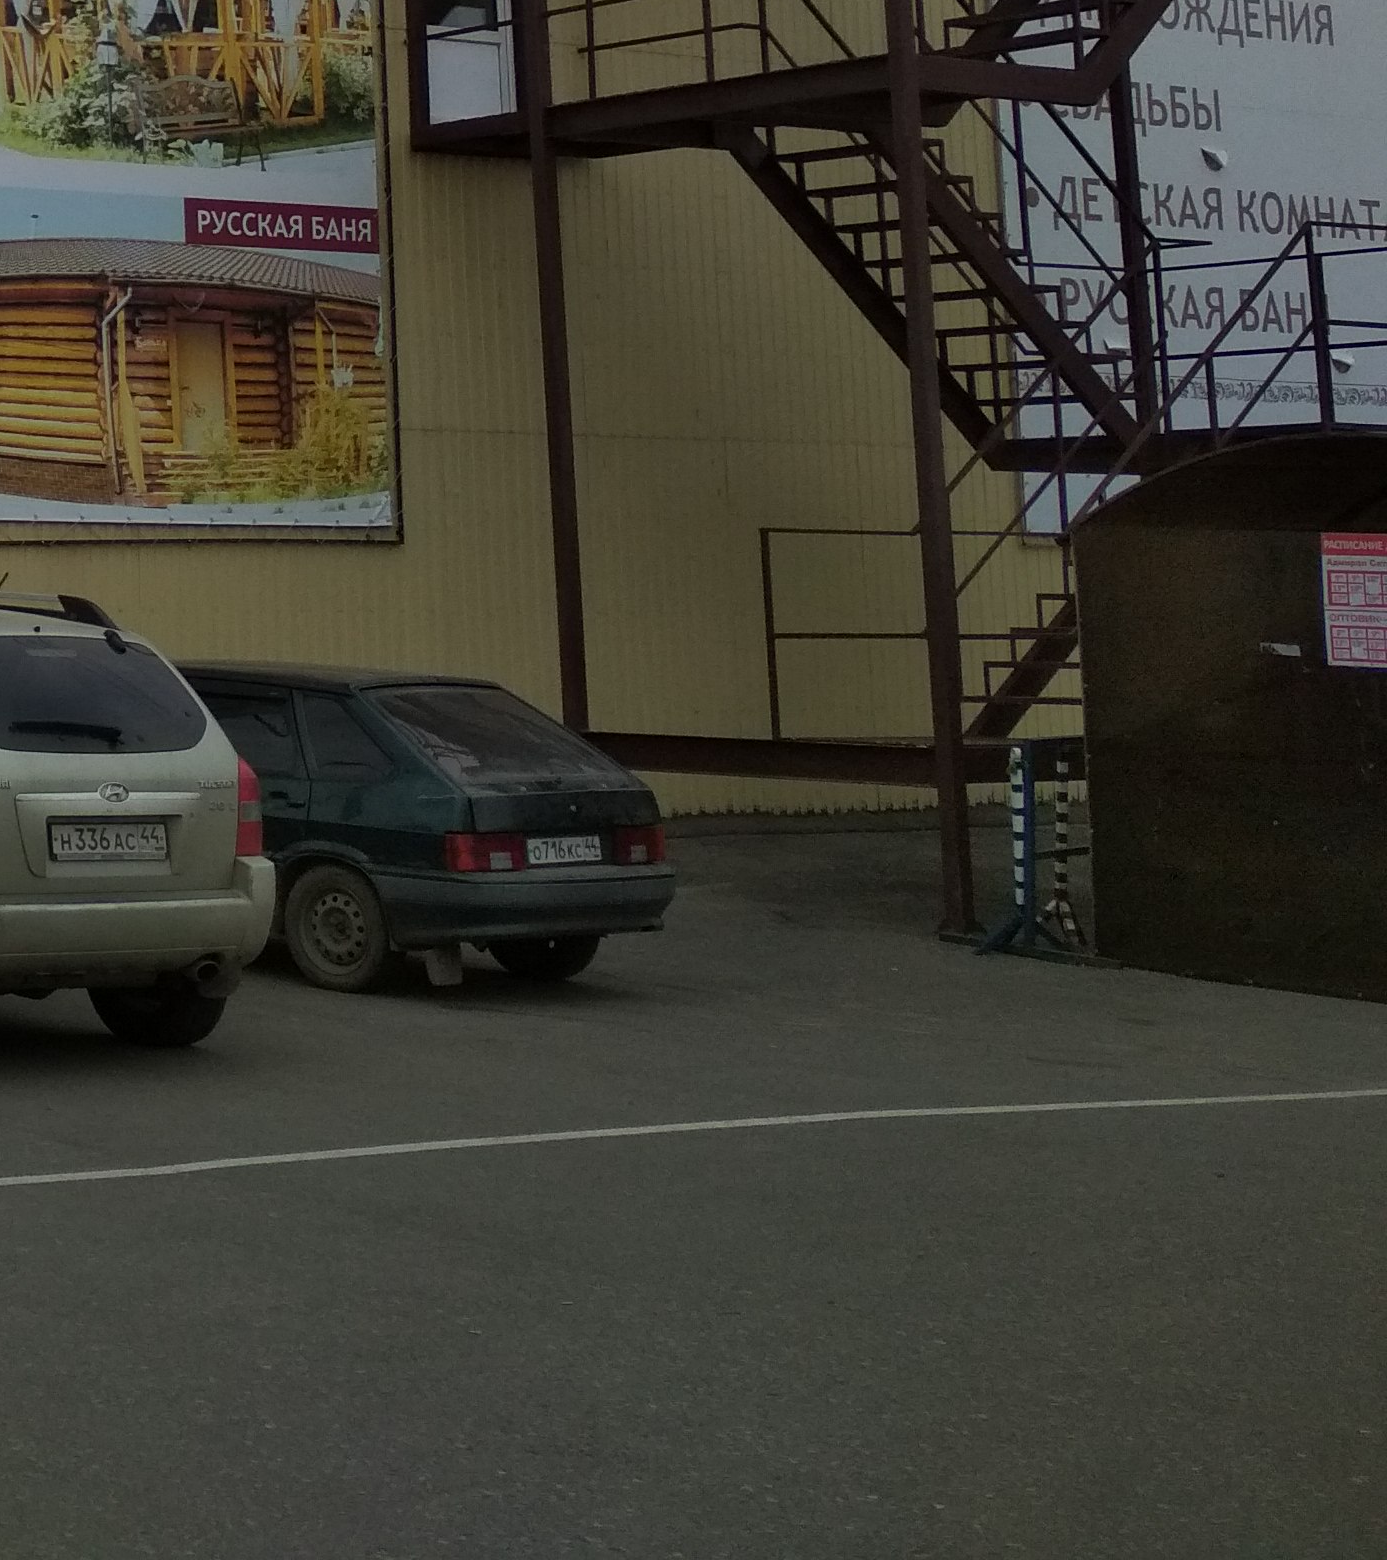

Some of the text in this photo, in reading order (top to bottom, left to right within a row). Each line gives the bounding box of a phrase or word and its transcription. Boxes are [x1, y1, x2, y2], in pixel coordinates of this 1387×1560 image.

[196, 209, 373, 243] РУССКАЯ БАНЯ
[1236, 188, 1387, 244] КОМНАТ
[1236, 286, 1328, 336] БАН
[140, 825, 160, 843] 44
